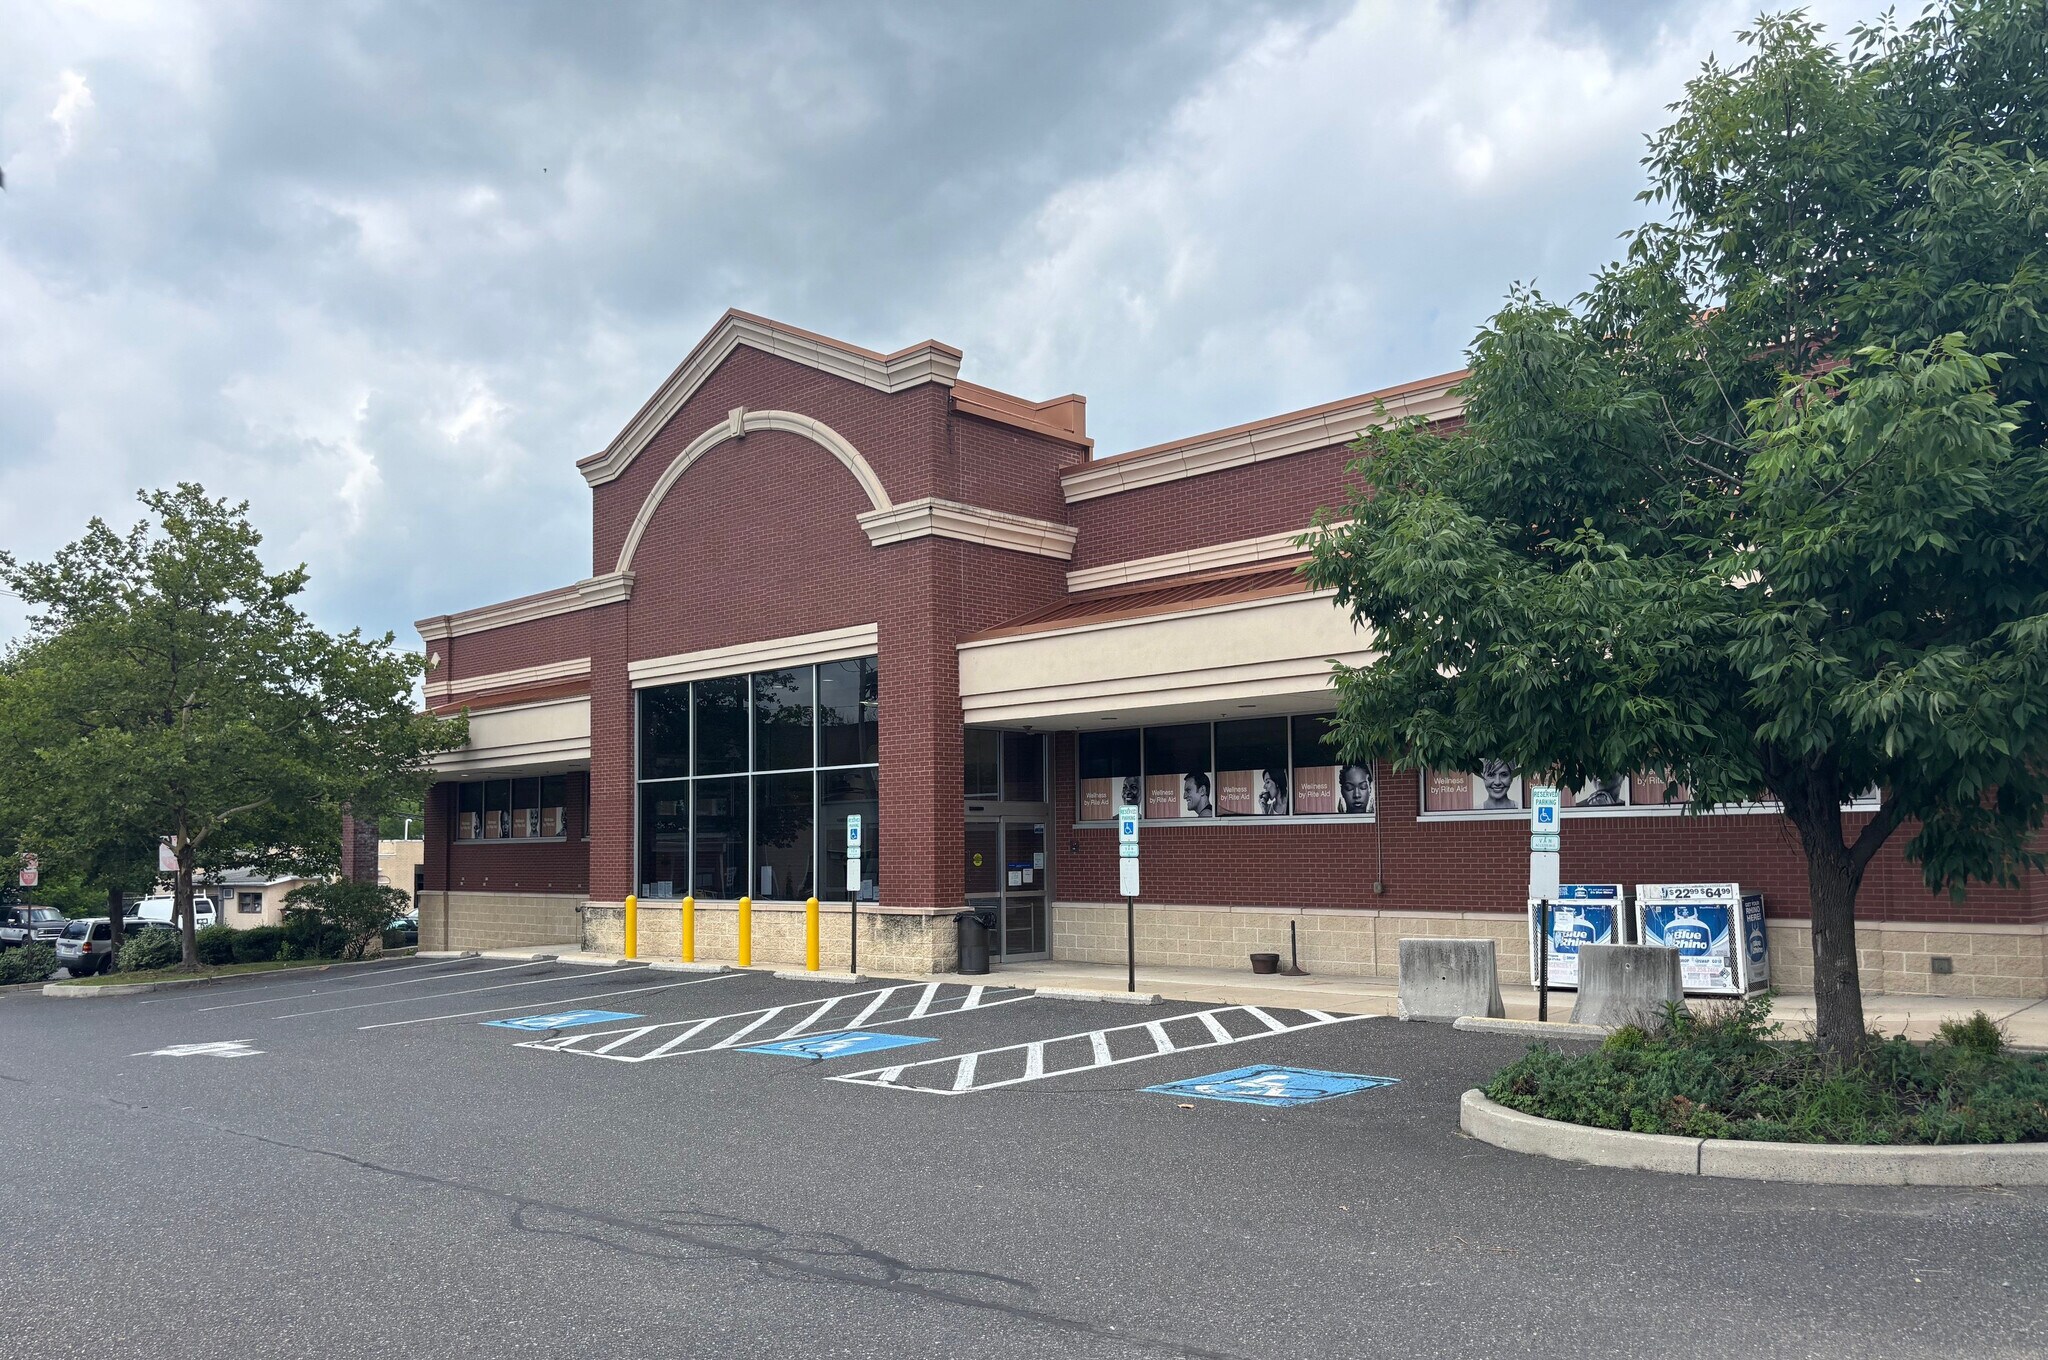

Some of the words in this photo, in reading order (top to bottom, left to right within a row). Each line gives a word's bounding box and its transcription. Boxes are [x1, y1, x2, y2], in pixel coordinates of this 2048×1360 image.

[1434, 777, 1464, 785] Wellness
[1638, 777, 1647, 786] by
[1456, 785, 1468, 793] Aid
[1562, 931, 1588, 939] Blue
[1674, 930, 1702, 940] Blue
[1673, 939, 1708, 949] Rhino
